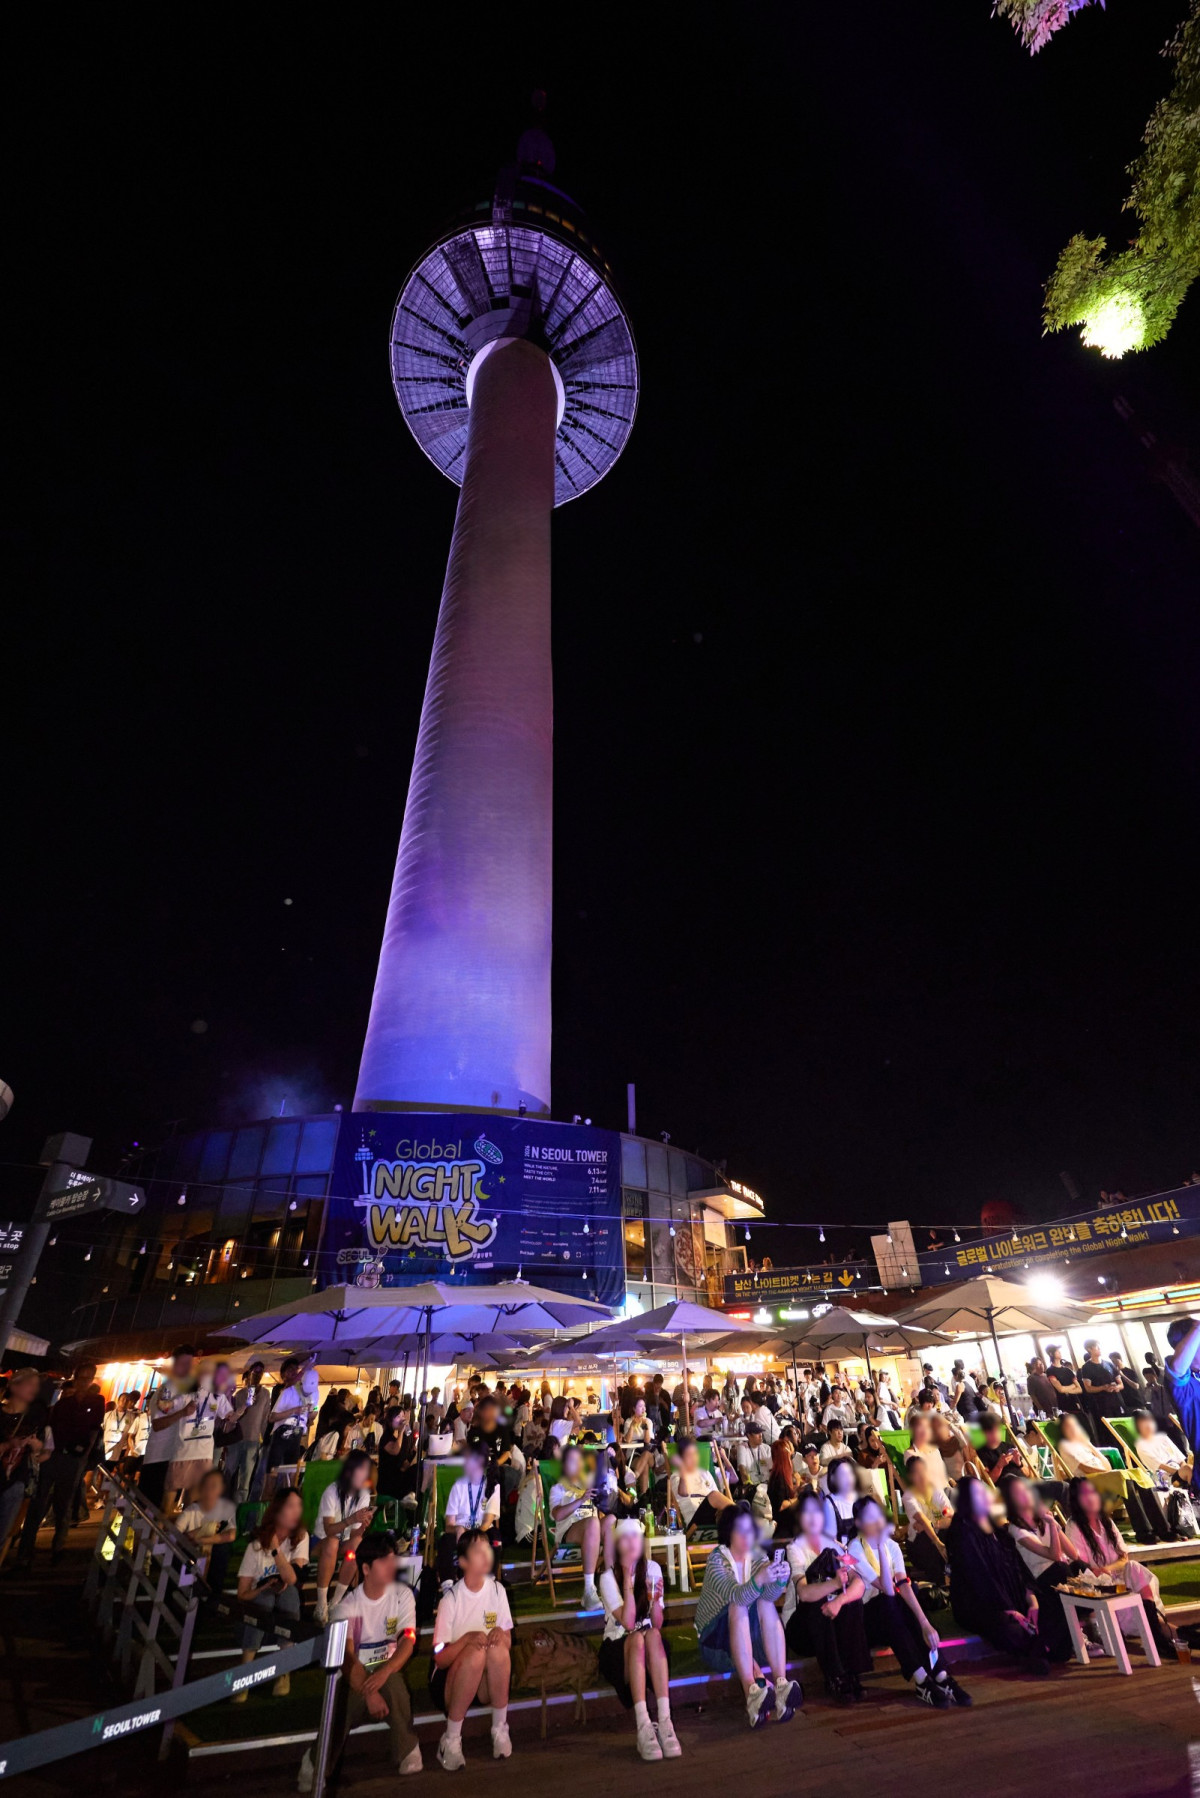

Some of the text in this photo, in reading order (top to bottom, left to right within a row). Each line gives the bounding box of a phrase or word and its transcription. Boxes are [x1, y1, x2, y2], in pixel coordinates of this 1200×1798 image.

[396, 1138, 462, 1160] Global
[531, 1146, 608, 1163] N SEOUL TOWER
[374, 1163, 481, 1201] NIGHT
[10, 1230, 23, 1242] 곳
[371, 1201, 491, 1256] WALK
[956, 1246, 989, 1267] 글로벌
[988, 1232, 1049, 1259] 나이트워크
[1048, 1221, 1093, 1247] 완보를
[1092, 1199, 1181, 1235] 축하합니다!
[1069, 1246, 1082, 1255] the
[1082, 1240, 1105, 1253] Global
[1105, 1236, 1127, 1249] Night
[1127, 1230, 1150, 1243] Walk!
[341, 1250, 371, 1262] SEOUL
[734, 1279, 752, 1291] 남산
[754, 1275, 800, 1289] 나이트마켓
[823, 1271, 833, 1284] 길
[232, 1675, 255, 1692] SEOUL
[254, 1665, 277, 1683] TOWER
[102, 1720, 132, 1740] SEOUL
[131, 1709, 162, 1729] TOWER
